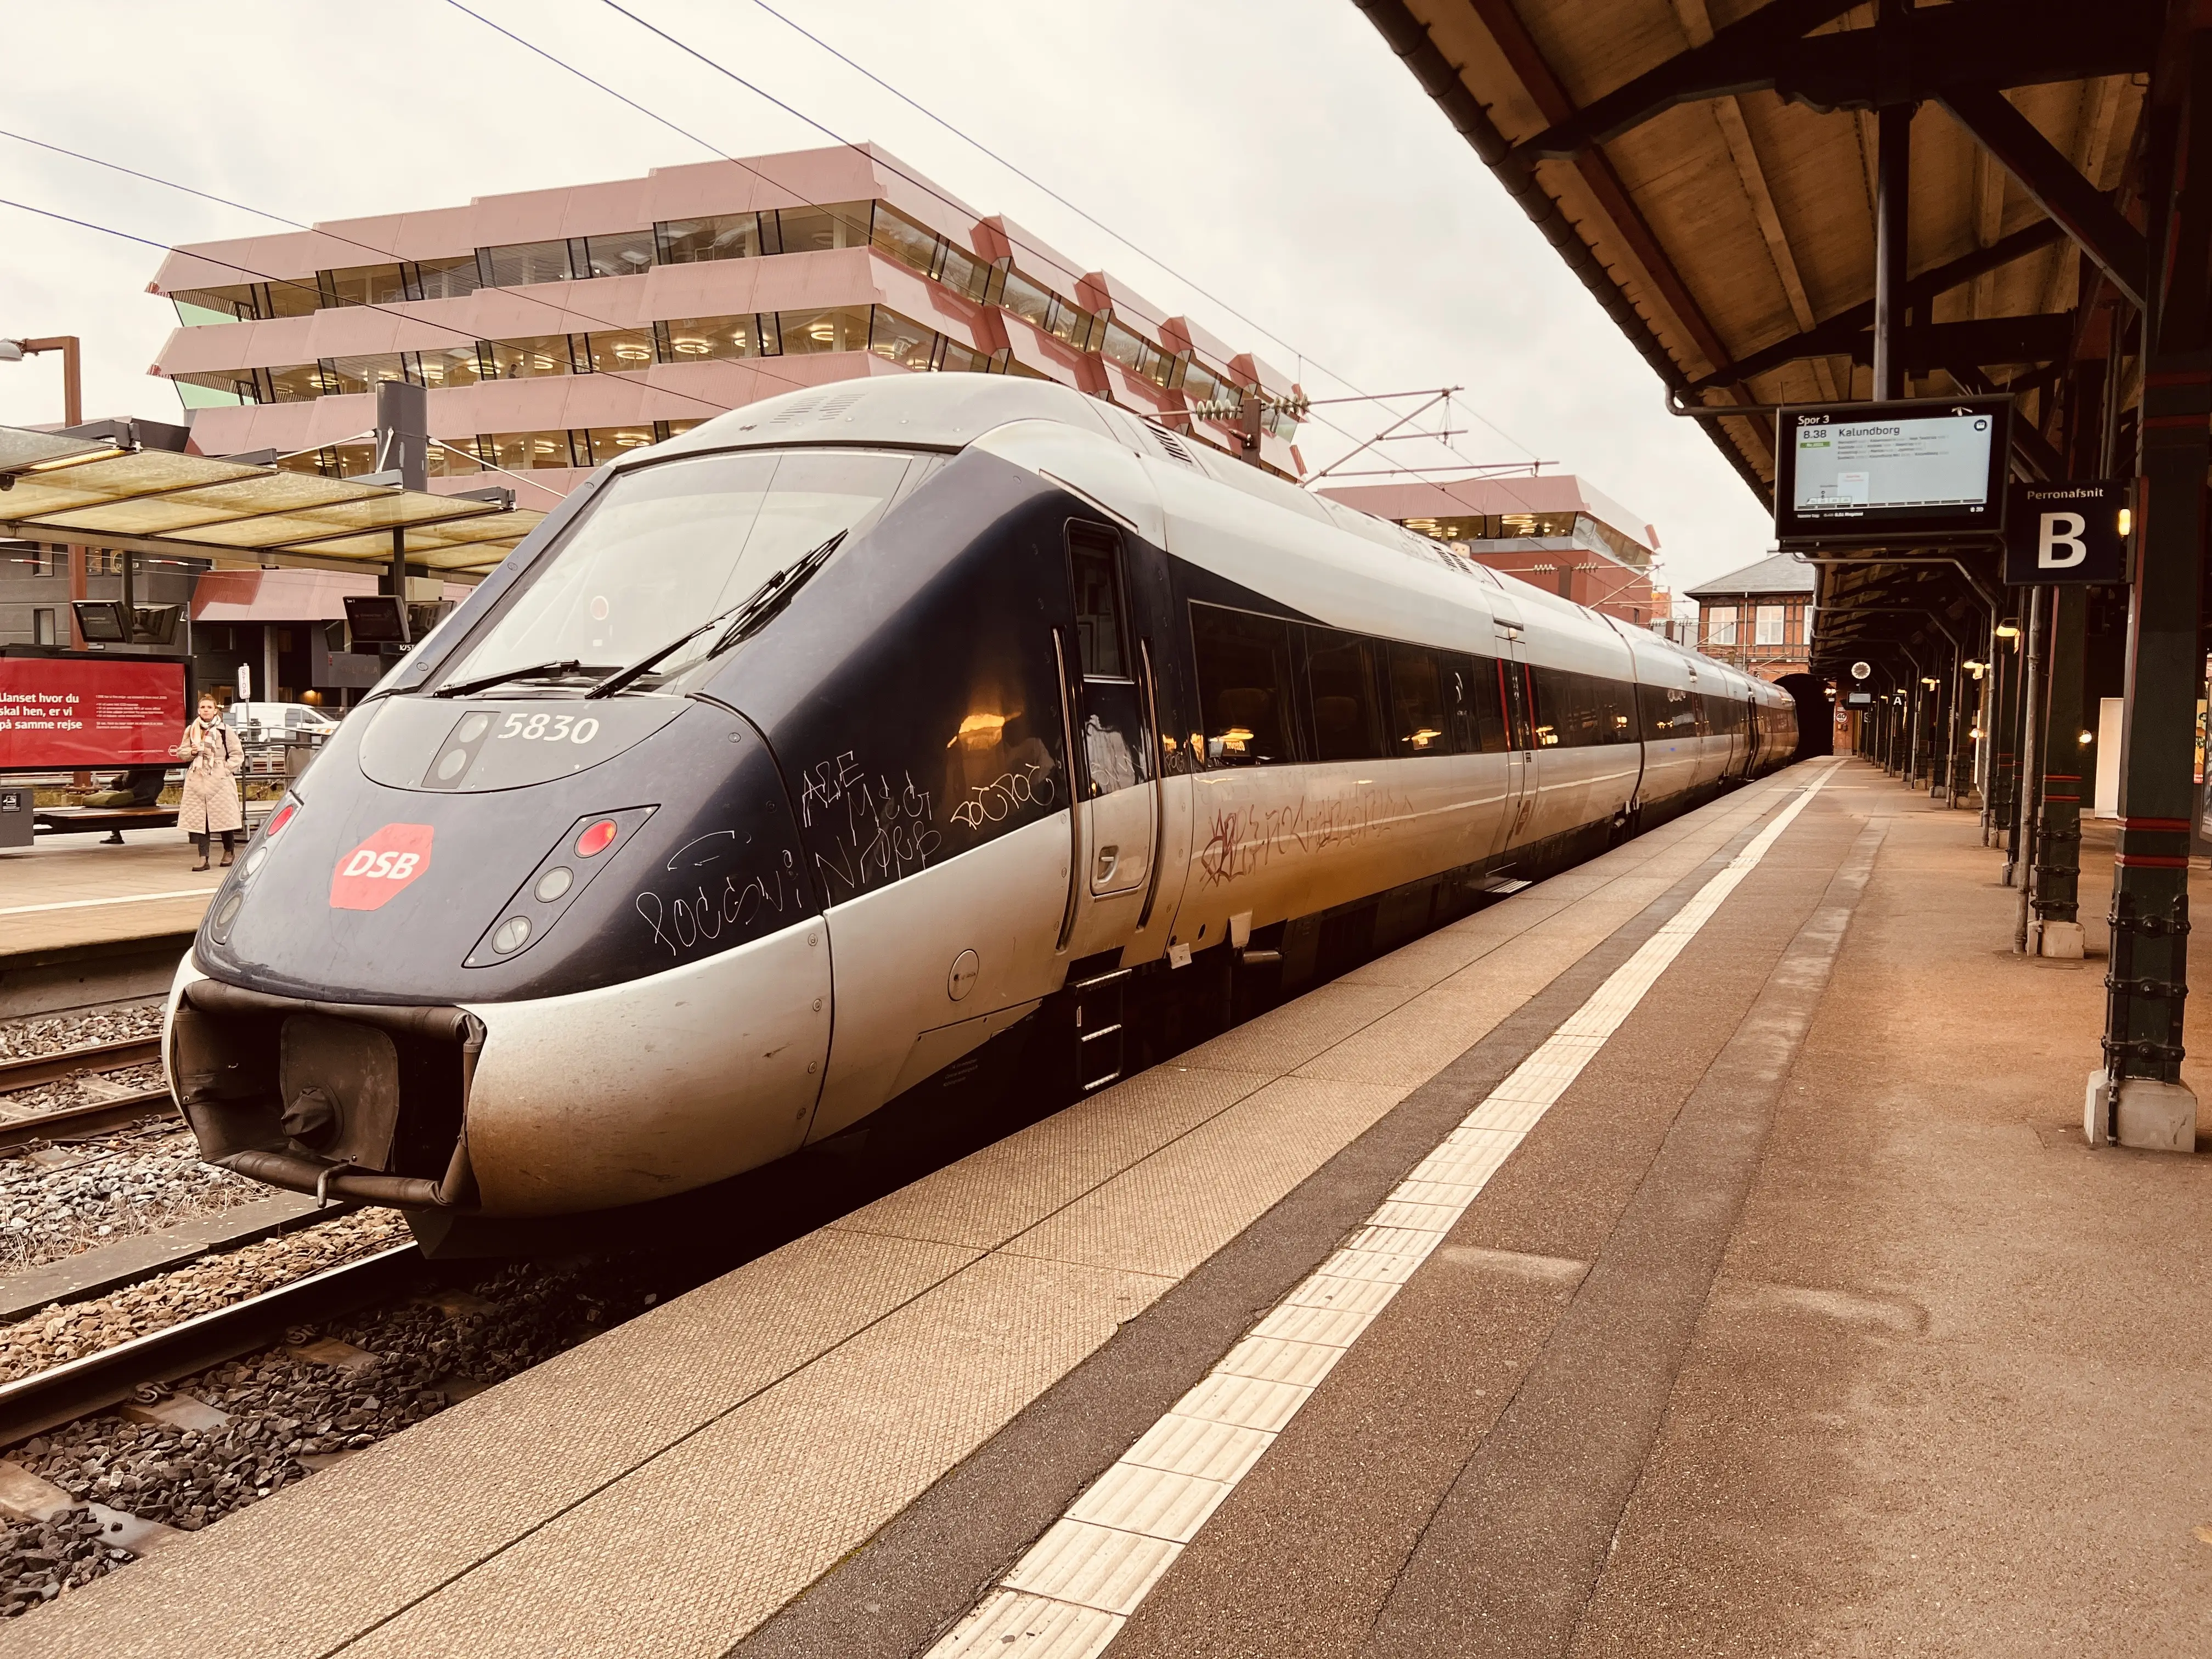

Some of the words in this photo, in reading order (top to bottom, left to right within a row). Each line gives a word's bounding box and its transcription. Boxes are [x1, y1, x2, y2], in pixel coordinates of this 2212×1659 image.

[1798, 415, 1820, 426] Spor
[1822, 415, 1830, 424] 3
[1803, 430, 1827, 439] 8.38
[1839, 427, 1900, 437] Kalundborg
[2027, 487, 2104, 500] Perronafsnit
[2038, 512, 2087, 568] B
[0, 692, 36, 703] Uanset
[39, 693, 63, 703] hvor
[66, 693, 80, 703] du
[1893, 697, 1902, 705] A
[0, 706, 20, 716] skal
[23, 706, 46, 718] hen,
[63, 707, 72, 716] vi
[0, 719, 12, 732] på
[15, 721, 55, 730] samme
[57, 720, 83, 731] rejse
[497, 713, 599, 744] 5830
[343, 849, 420, 880] DSB
